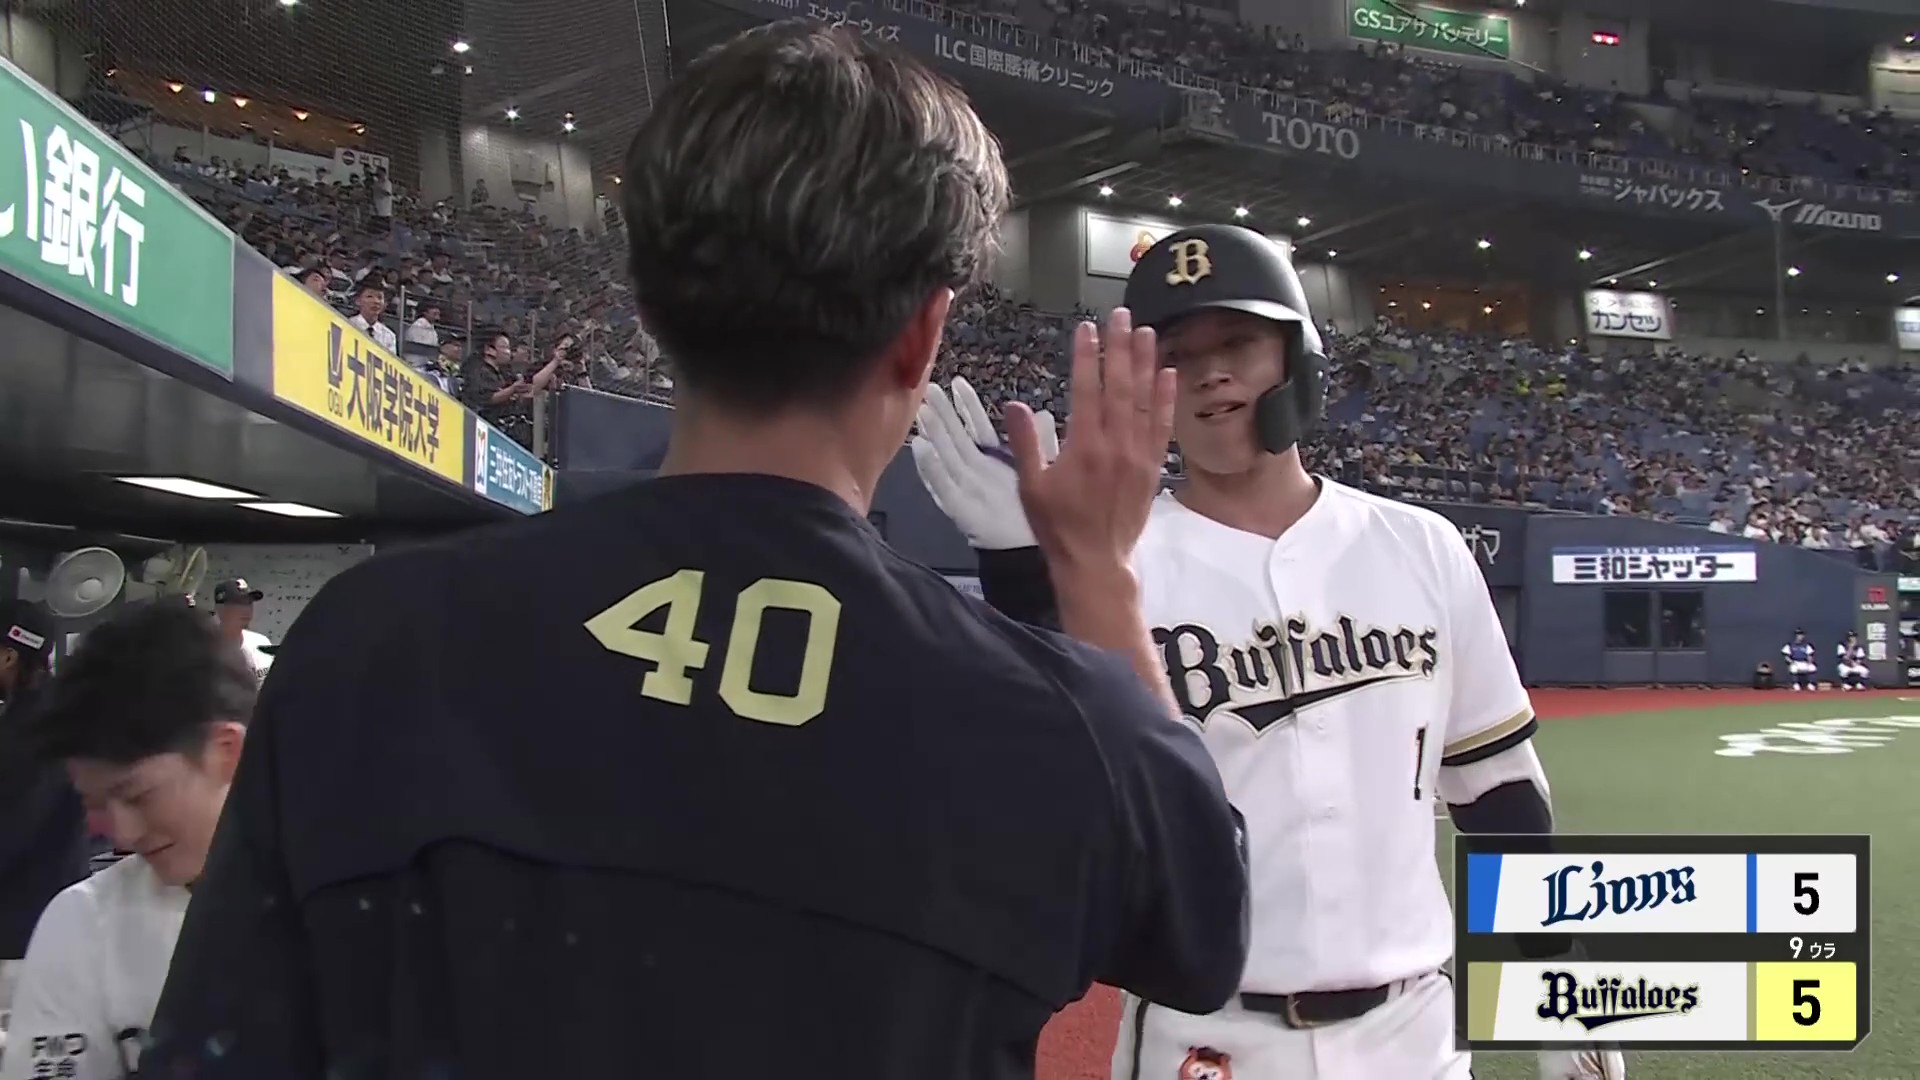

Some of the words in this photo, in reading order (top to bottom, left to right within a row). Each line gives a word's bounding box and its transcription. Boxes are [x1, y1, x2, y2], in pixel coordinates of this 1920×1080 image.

[1262, 111, 1359, 159] TOTO
[1613, 177, 1725, 211] ジャパックス
[1166, 239, 1212, 285] B
[1591, 309, 1662, 333] カンセツ
[347, 338, 440, 464] 大阪学院大学
[1574, 555, 1734, 580] 三和シャッター
[583, 568, 842, 727] 40
[1151, 611, 1437, 732] Buffaloes
[1413, 726, 1427, 800] 1
